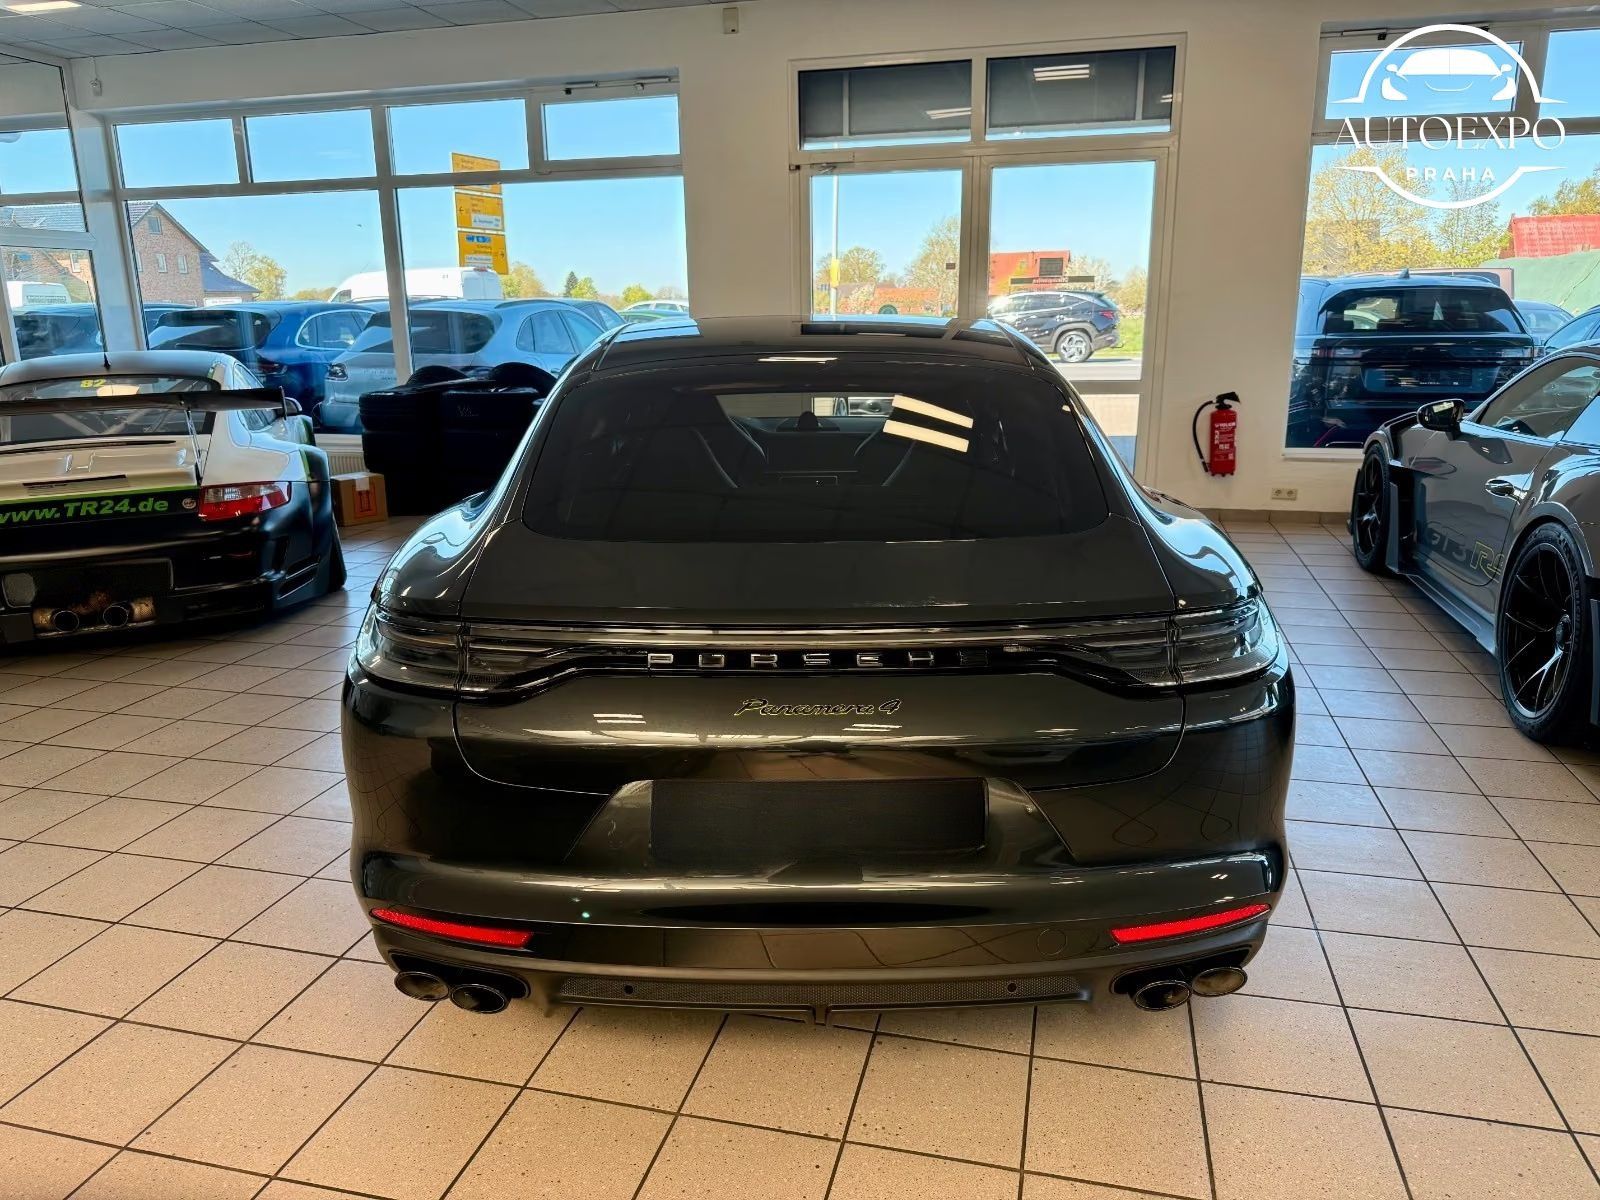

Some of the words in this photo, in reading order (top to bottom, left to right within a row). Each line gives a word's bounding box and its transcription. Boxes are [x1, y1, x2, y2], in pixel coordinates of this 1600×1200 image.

[80, 378, 106, 388] 82
[647, 651, 989, 668] PORSCH
[733, 698, 874, 715] Panamera
[878, 698, 902, 715] 4
